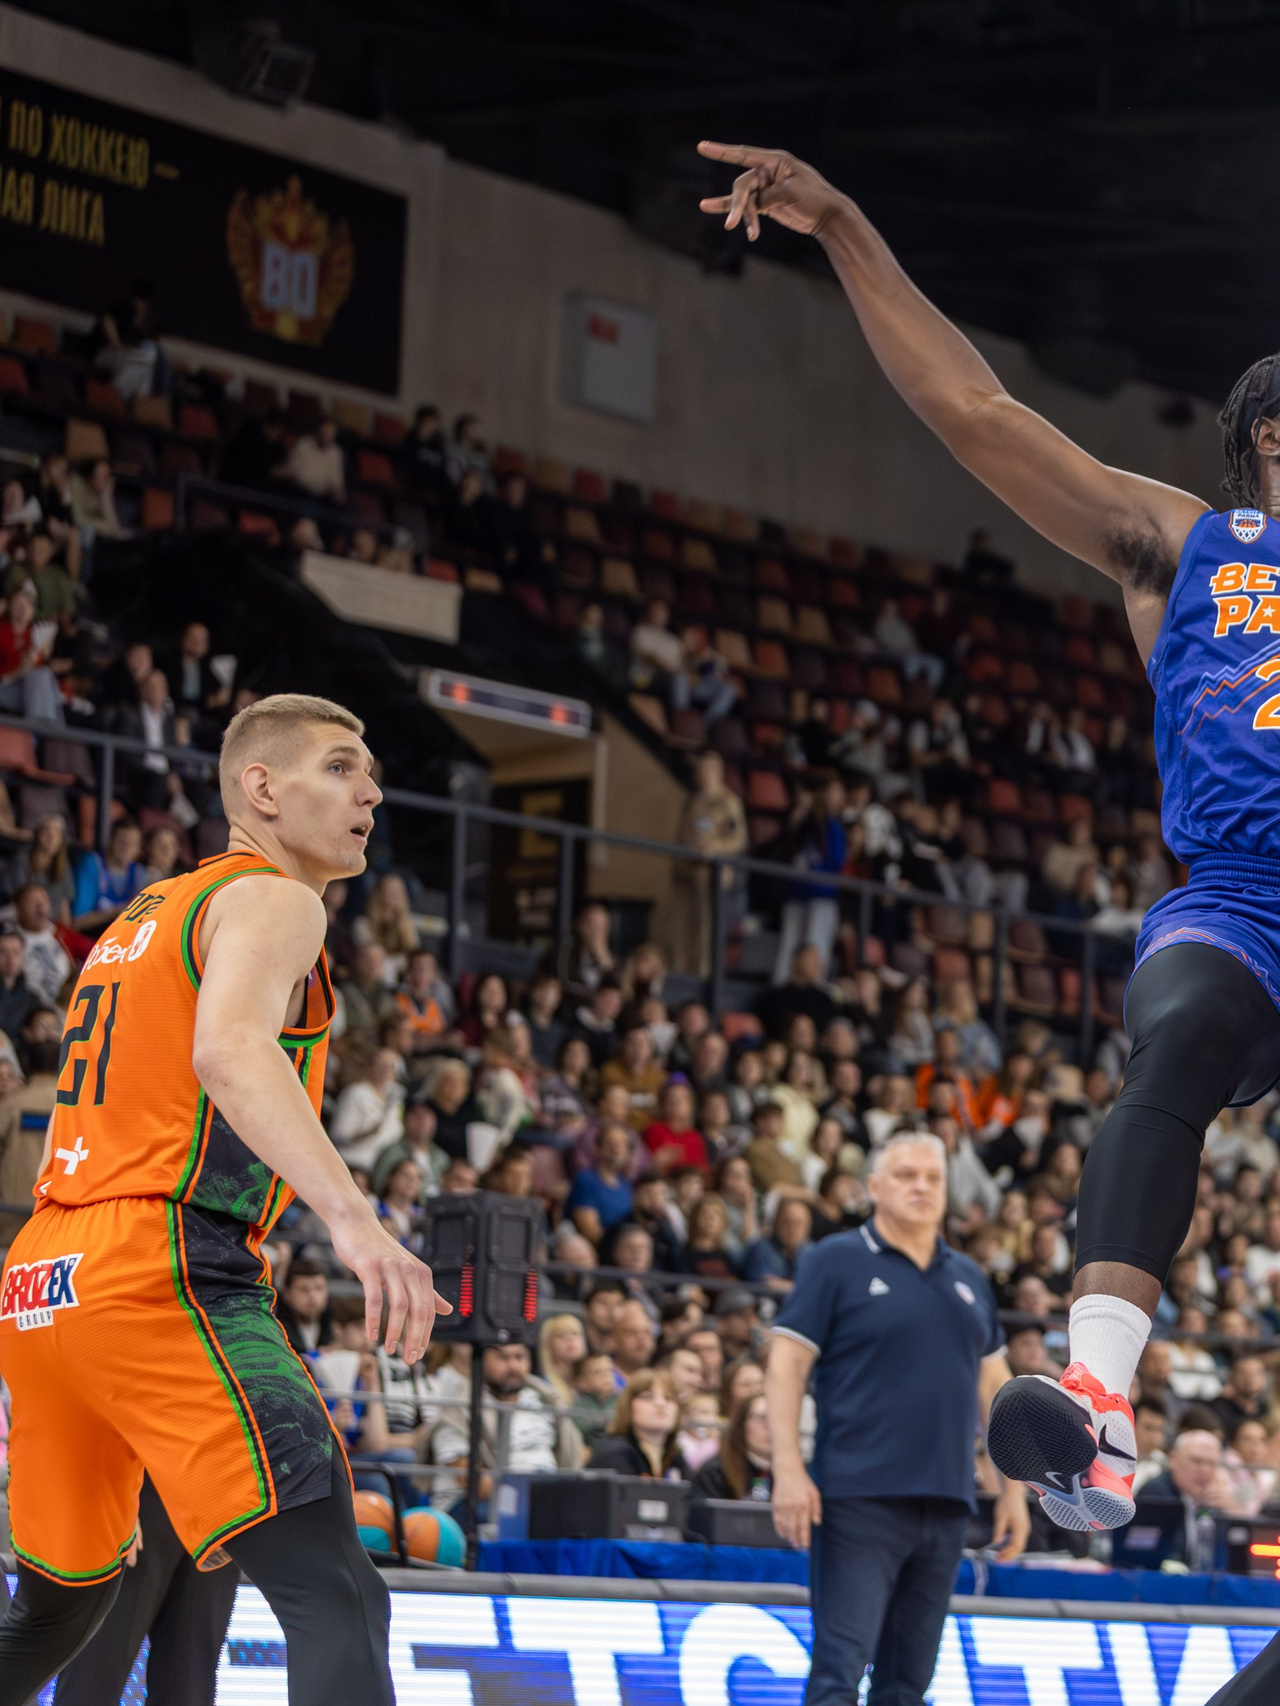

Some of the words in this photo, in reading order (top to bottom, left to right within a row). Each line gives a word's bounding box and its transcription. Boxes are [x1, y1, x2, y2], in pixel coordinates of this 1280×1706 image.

[9, 100, 43, 158] ПО
[48, 114, 151, 191] ХОККЕЮ
[0, 166, 35, 226] АЯ
[40, 180, 106, 247] ЛИГА
[56, 982, 121, 1107] 21
[19, 1310, 52, 1328] GROUP
